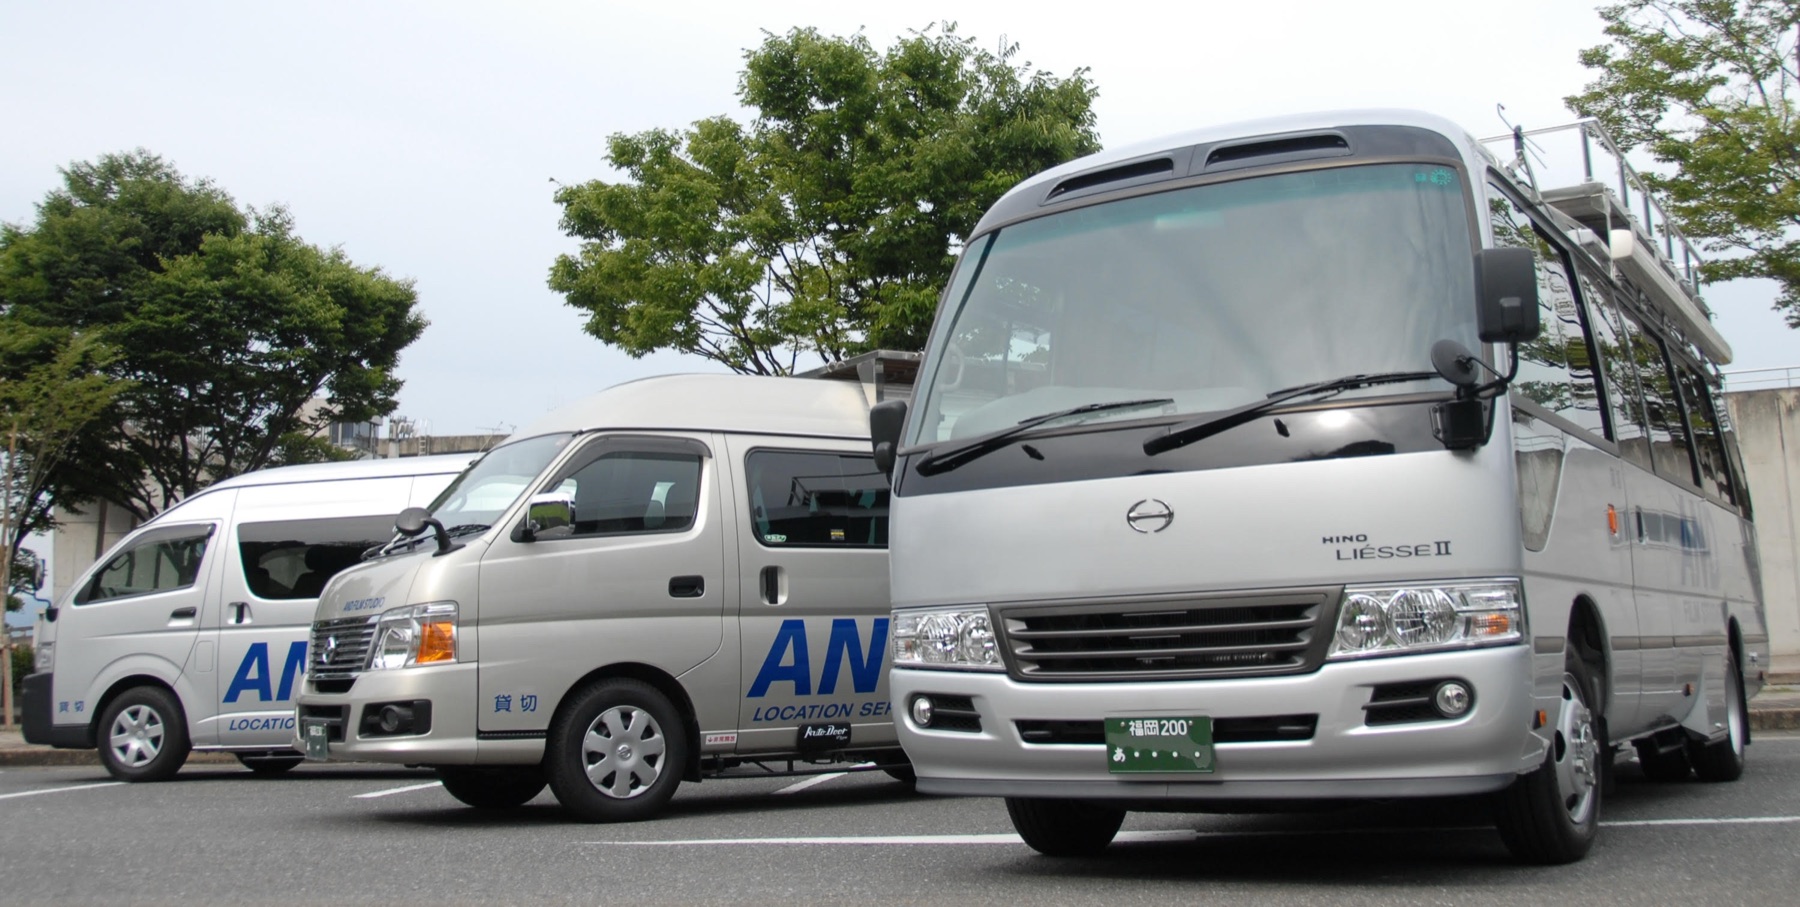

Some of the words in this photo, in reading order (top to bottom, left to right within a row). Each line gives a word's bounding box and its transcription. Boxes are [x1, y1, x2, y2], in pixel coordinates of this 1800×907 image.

[1322, 534, 1368, 544] HINO
[746, 618, 890, 697] AN
[494, 695, 537, 712] 貸切
[753, 703, 854, 721] LOCATION
[229, 718, 295, 731] LOCATIO
[1113, 747, 1126, 763] あ
